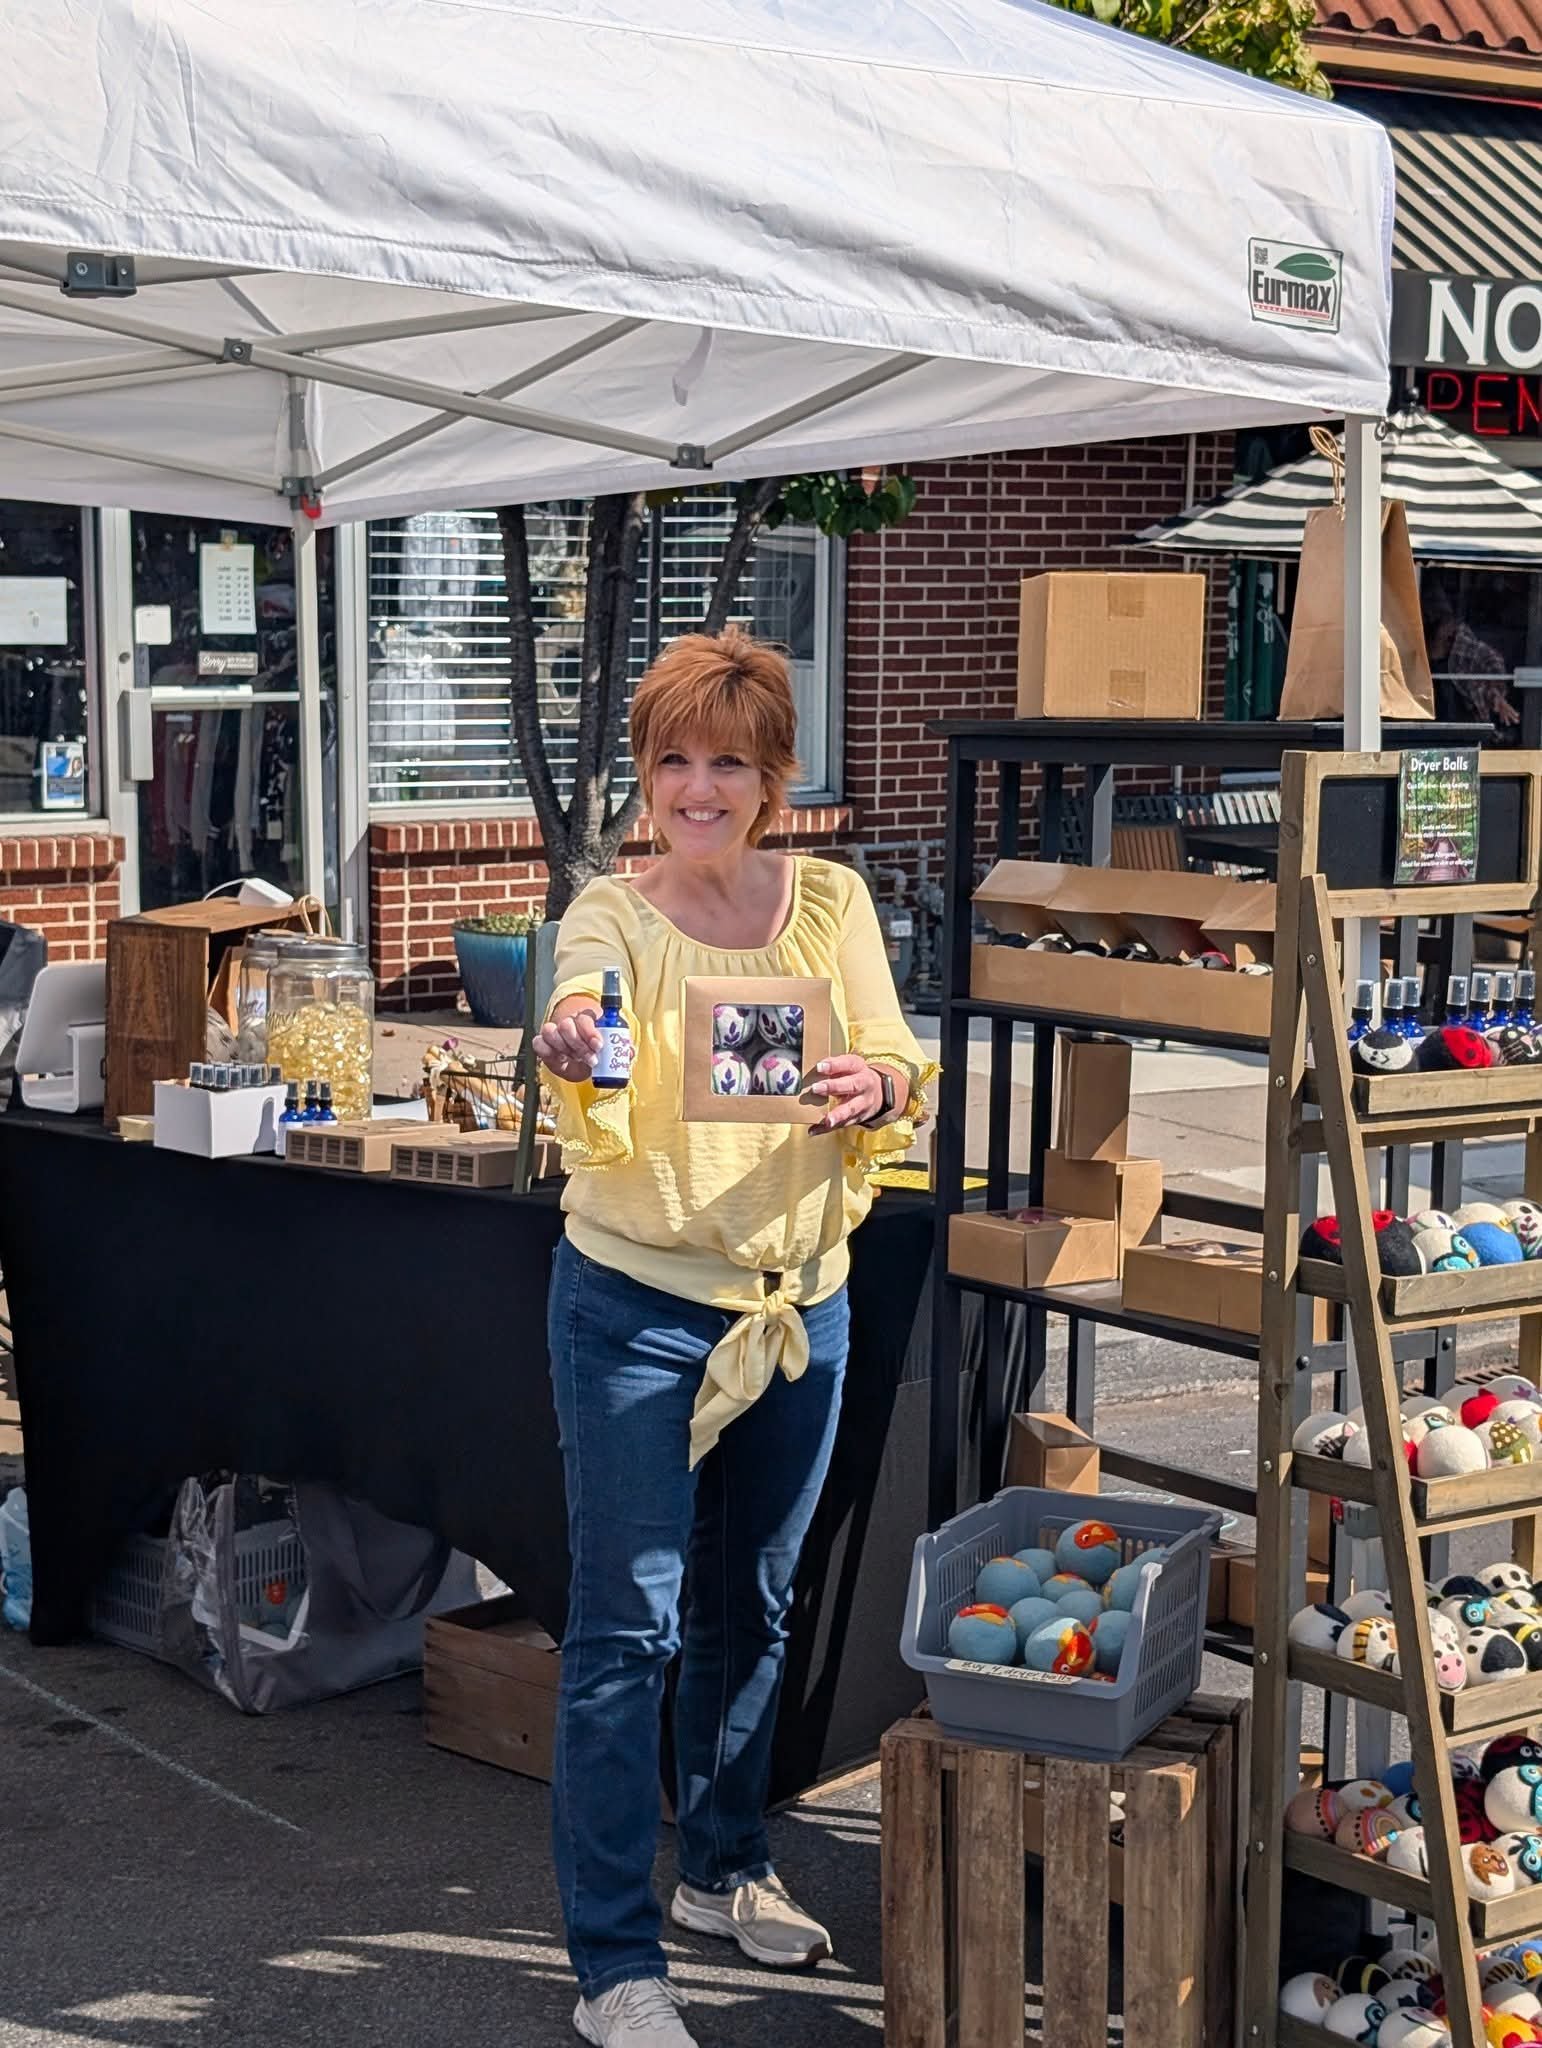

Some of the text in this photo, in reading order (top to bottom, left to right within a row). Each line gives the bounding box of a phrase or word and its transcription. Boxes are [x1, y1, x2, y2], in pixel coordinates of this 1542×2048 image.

[1252, 269, 1332, 313] Eurmax
[1424, 279, 1542, 369] NO
[1411, 756, 1468, 775] Dryer Balls
[961, 1661, 985, 1672] Buy
[992, 1664, 1000, 1673] 4
